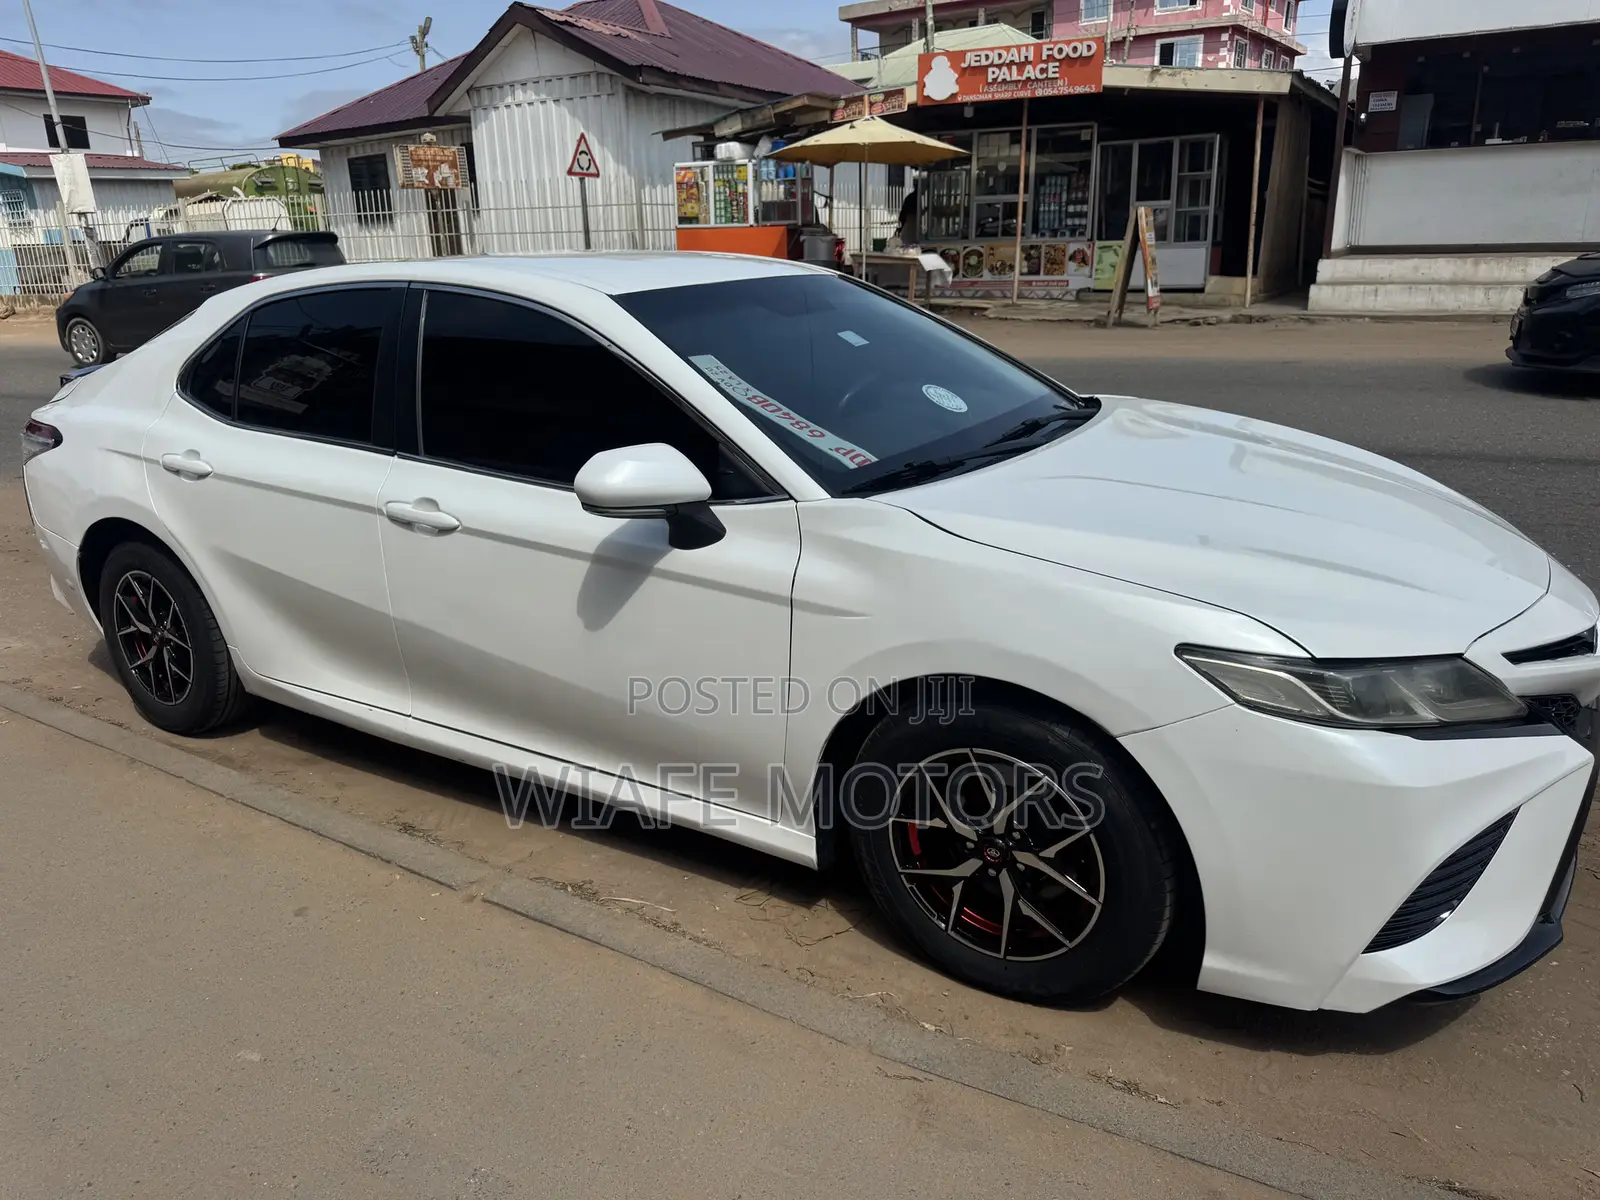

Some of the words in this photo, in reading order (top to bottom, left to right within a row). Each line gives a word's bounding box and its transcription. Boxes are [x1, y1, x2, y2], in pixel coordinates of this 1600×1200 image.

[961, 45, 1034, 67] JEDDAH
[1041, 40, 1097, 60] FOOD
[987, 62, 1060, 83] PALACE
[834, 447, 873, 467] DP
